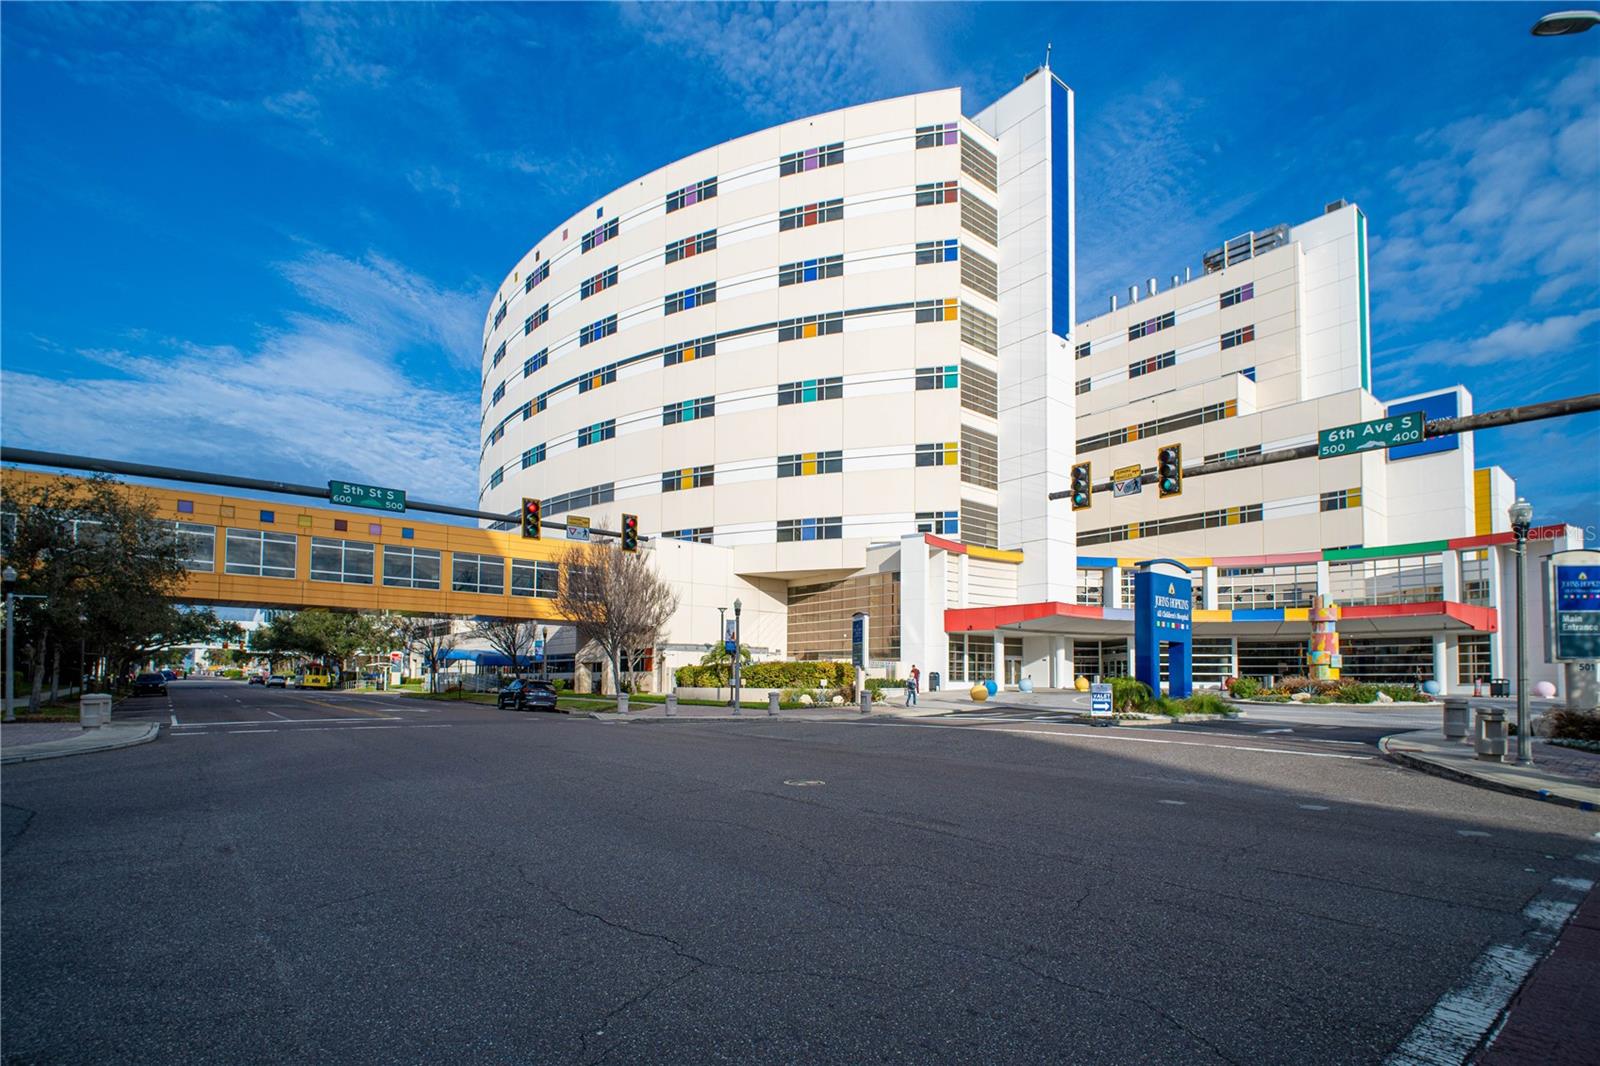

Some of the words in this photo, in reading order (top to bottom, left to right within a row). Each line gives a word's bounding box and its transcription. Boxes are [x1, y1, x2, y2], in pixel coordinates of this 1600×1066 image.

[1328, 428, 1355, 442] 6th
[1362, 422, 1394, 437] Ave
[1401, 416, 1413, 429] S
[1322, 443, 1346, 455] 500
[1392, 430, 1419, 442] 400
[343, 484, 364, 496] 5th
[368, 488, 383, 498] St
[386, 491, 395, 500] S
[333, 494, 352, 504] 600
[385, 501, 403, 510] 500
[1562, 614, 1583, 622] Main
[1562, 623, 1599, 631] Entrance
[1579, 663, 1595, 671] 501
